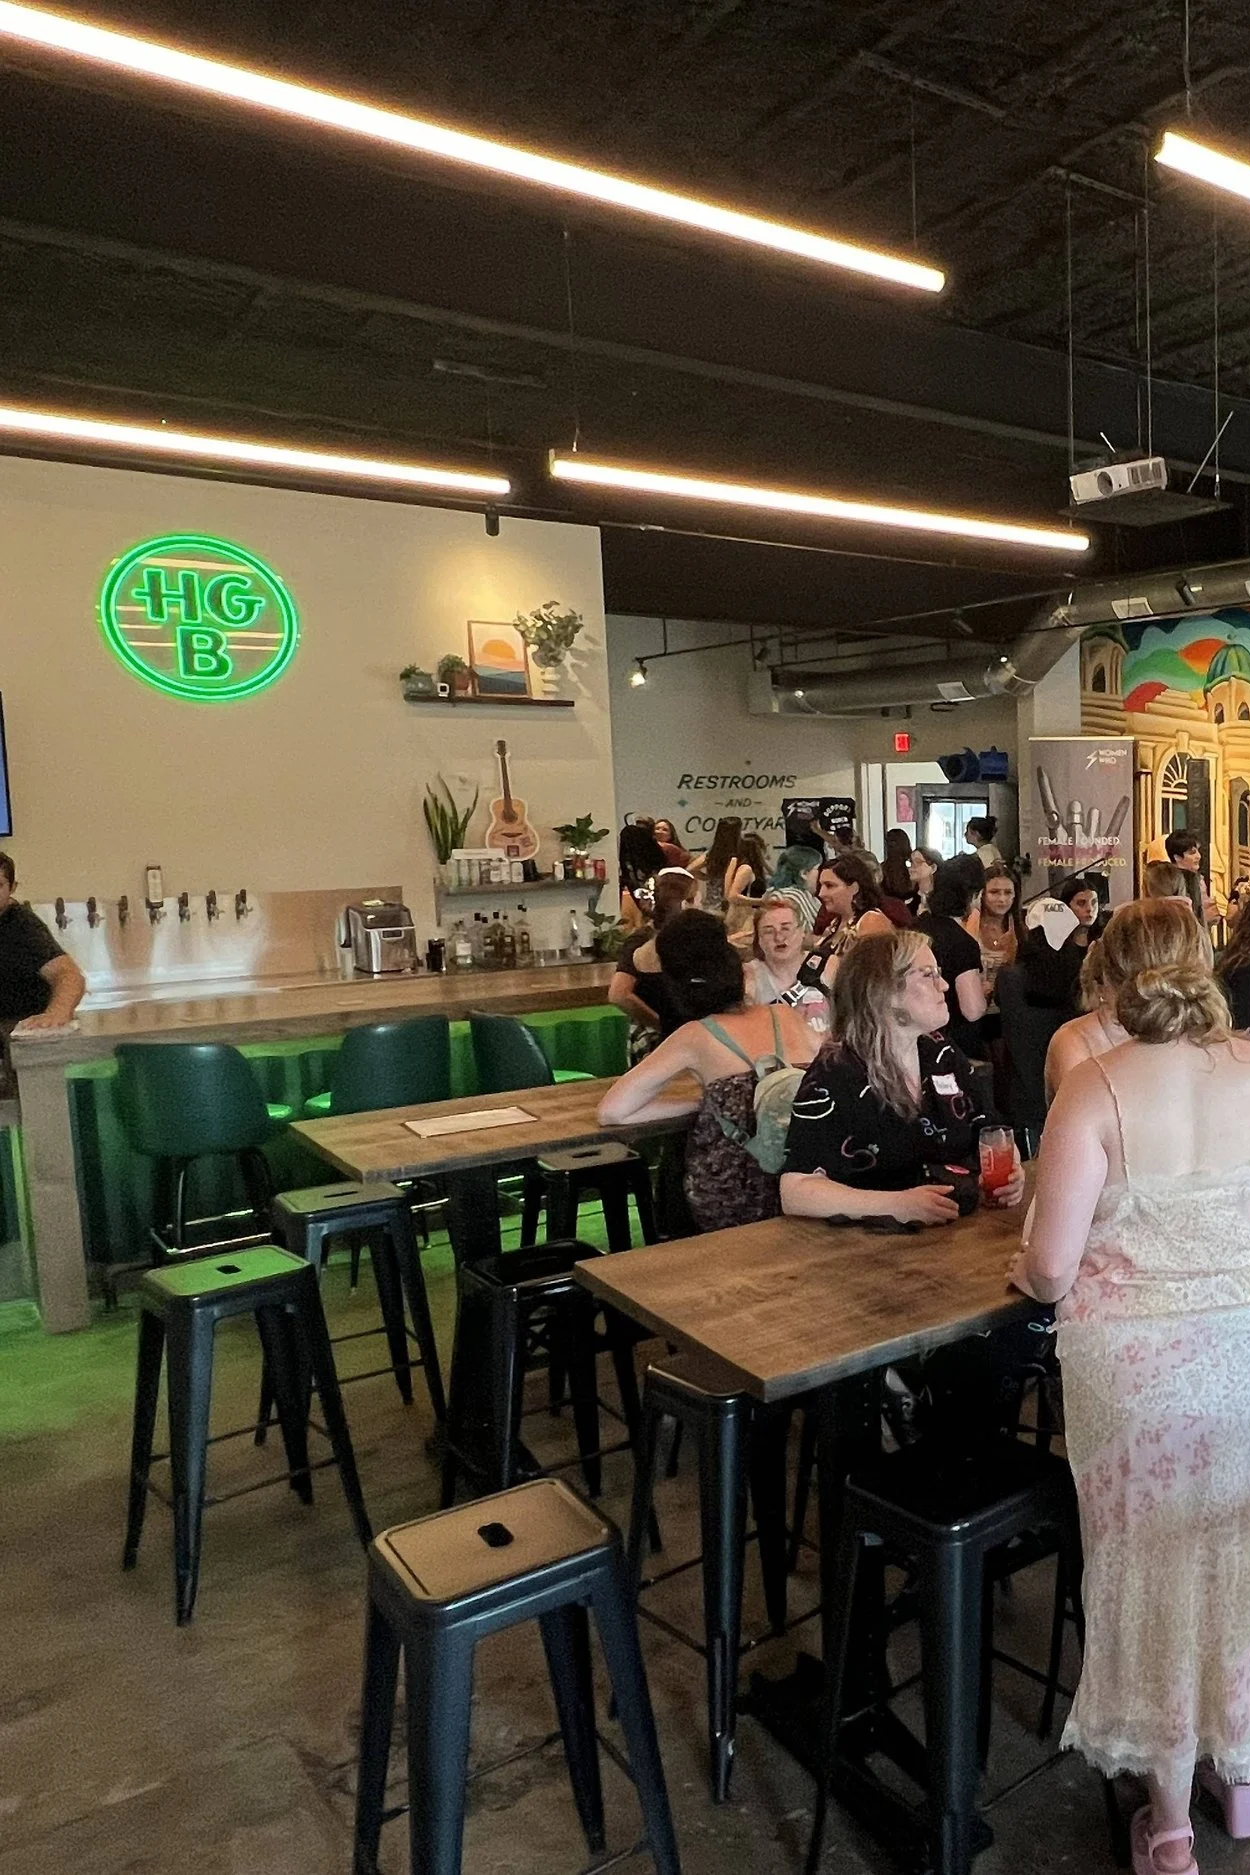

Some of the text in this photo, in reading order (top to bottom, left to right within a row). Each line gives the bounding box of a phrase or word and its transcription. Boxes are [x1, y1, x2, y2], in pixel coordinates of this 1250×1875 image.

[176, 626, 233, 680] B
[677, 774, 797, 790] RESTROOMS
[725, 798, 752, 808] AND
[1038, 837, 1074, 846] FEMALE
